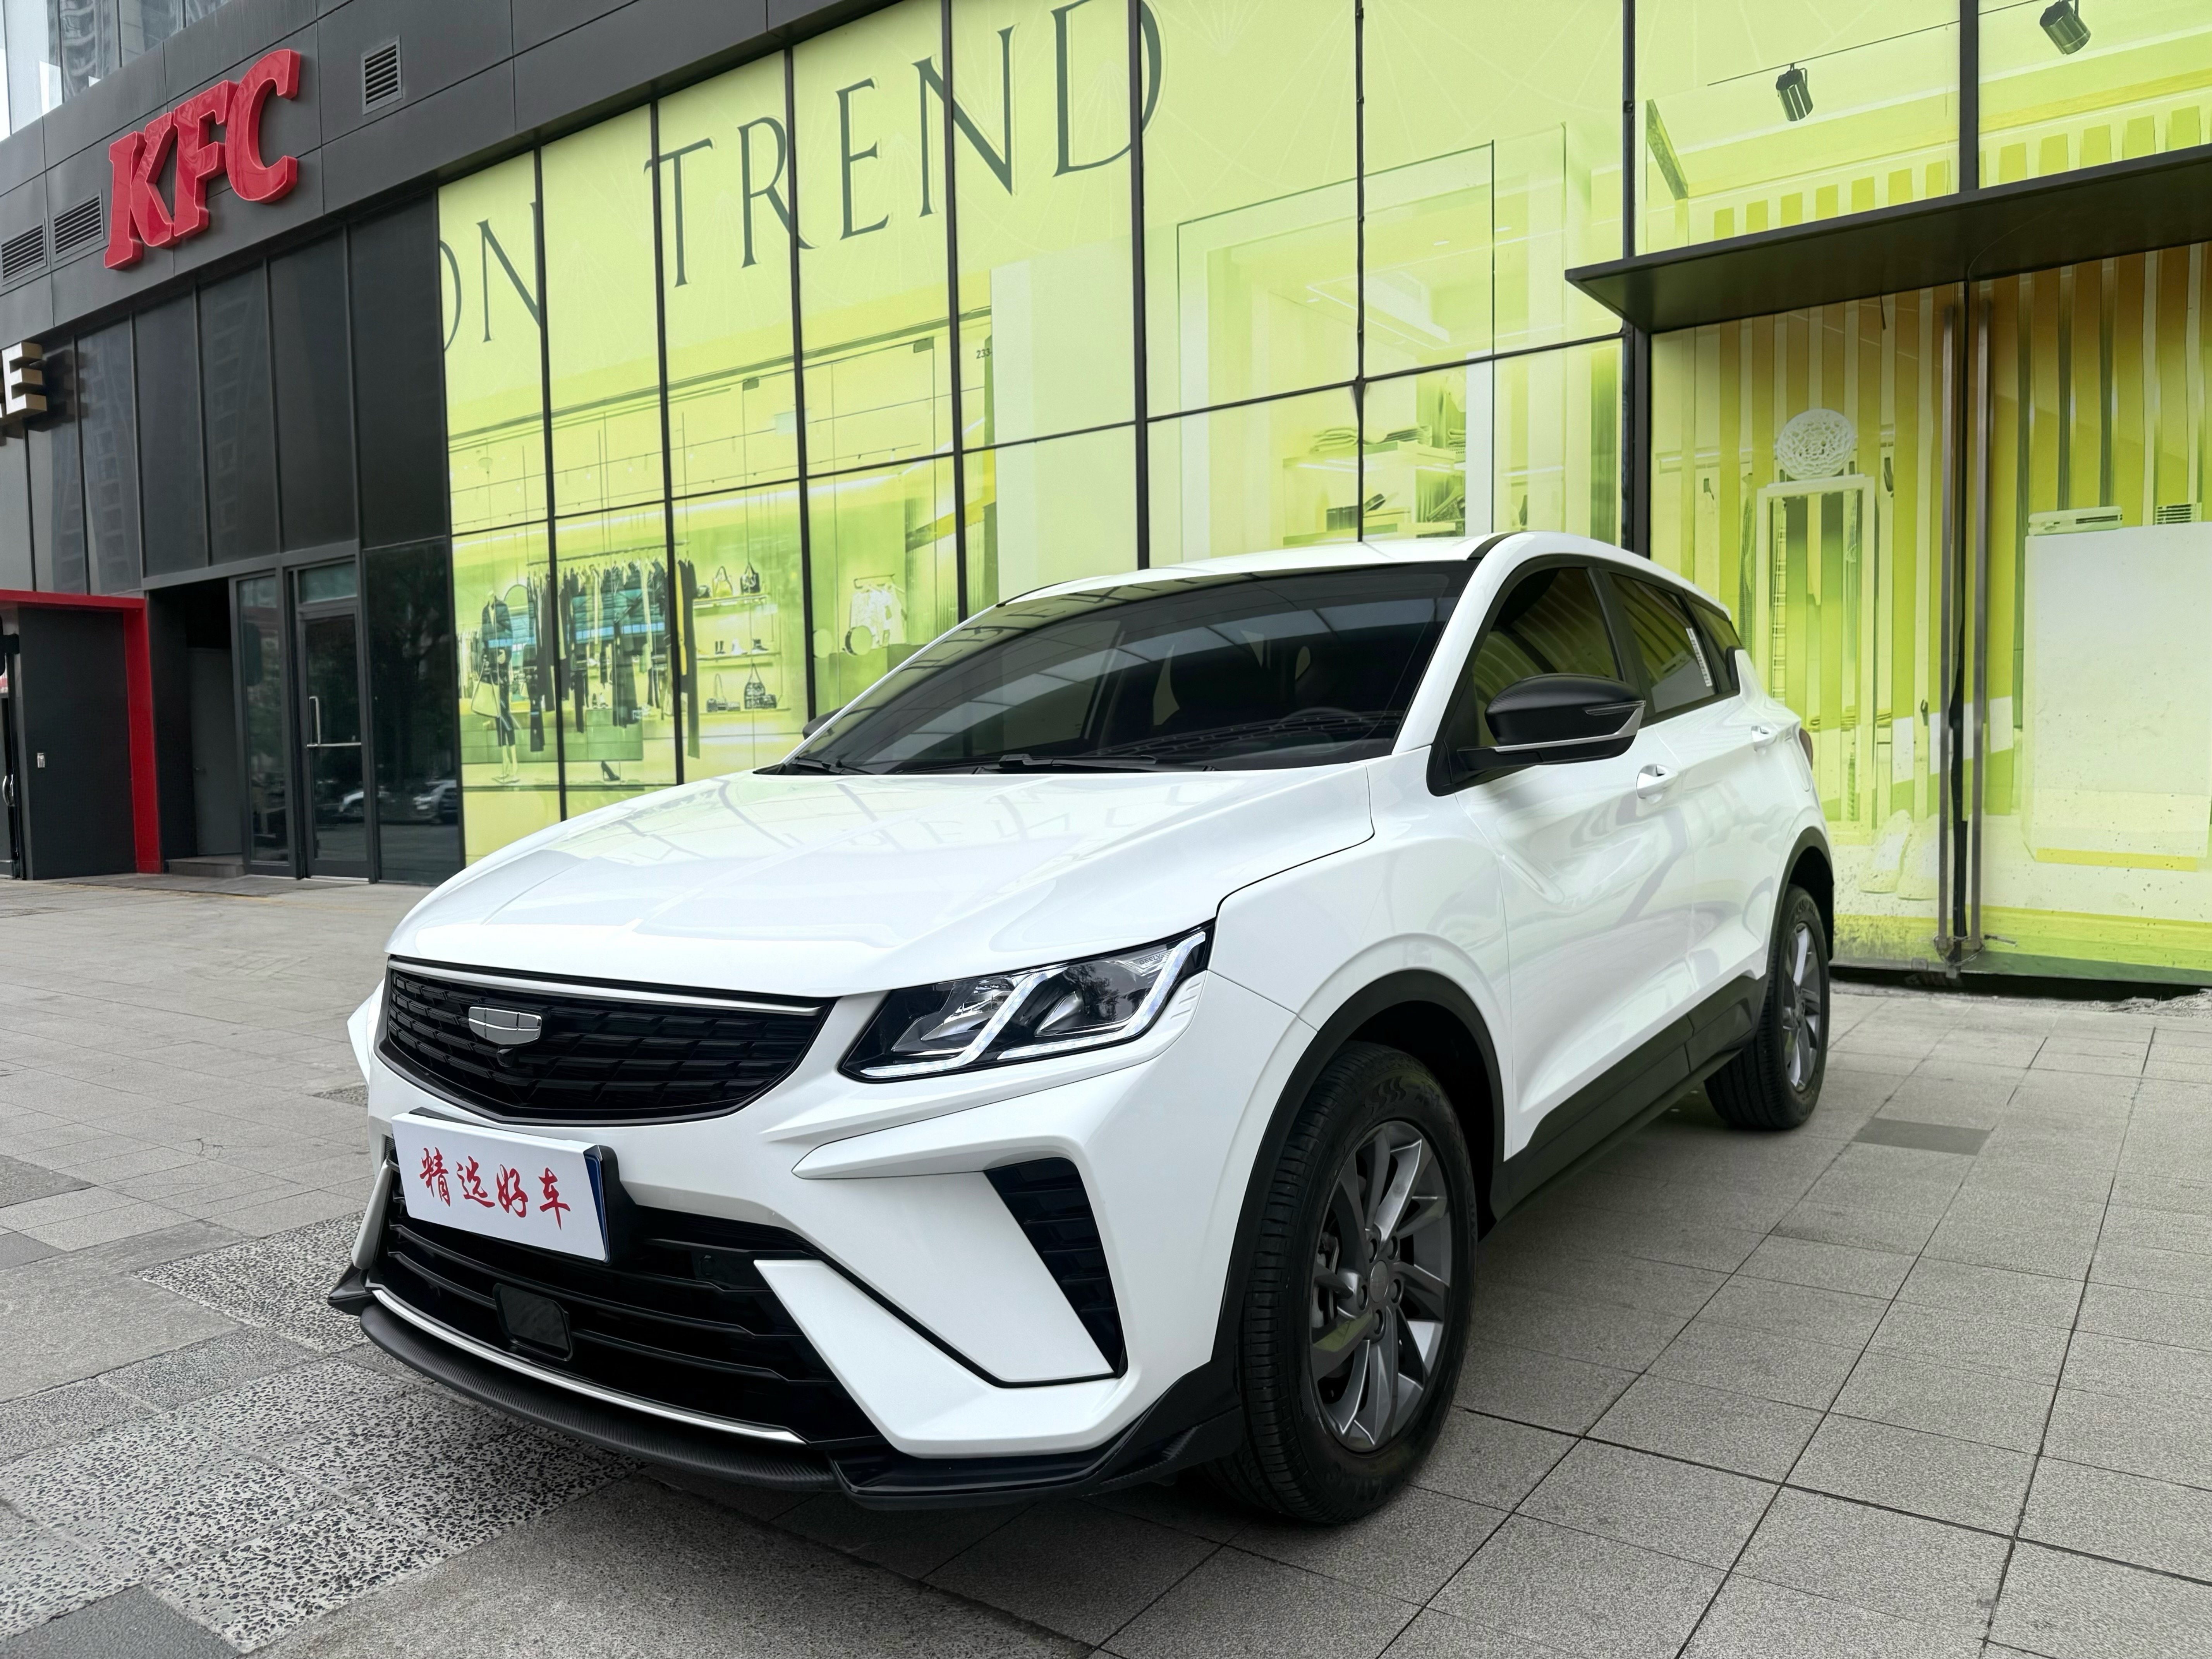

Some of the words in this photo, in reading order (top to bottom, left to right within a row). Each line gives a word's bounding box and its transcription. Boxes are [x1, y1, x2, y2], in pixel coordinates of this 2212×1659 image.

[104, 48, 301, 270] KFC
[439, 201, 542, 352] N
[644, 0, 1162, 288] TREND
[1139, 954, 1160, 965] GEELY
[419, 1146, 571, 1231] 精选好车
